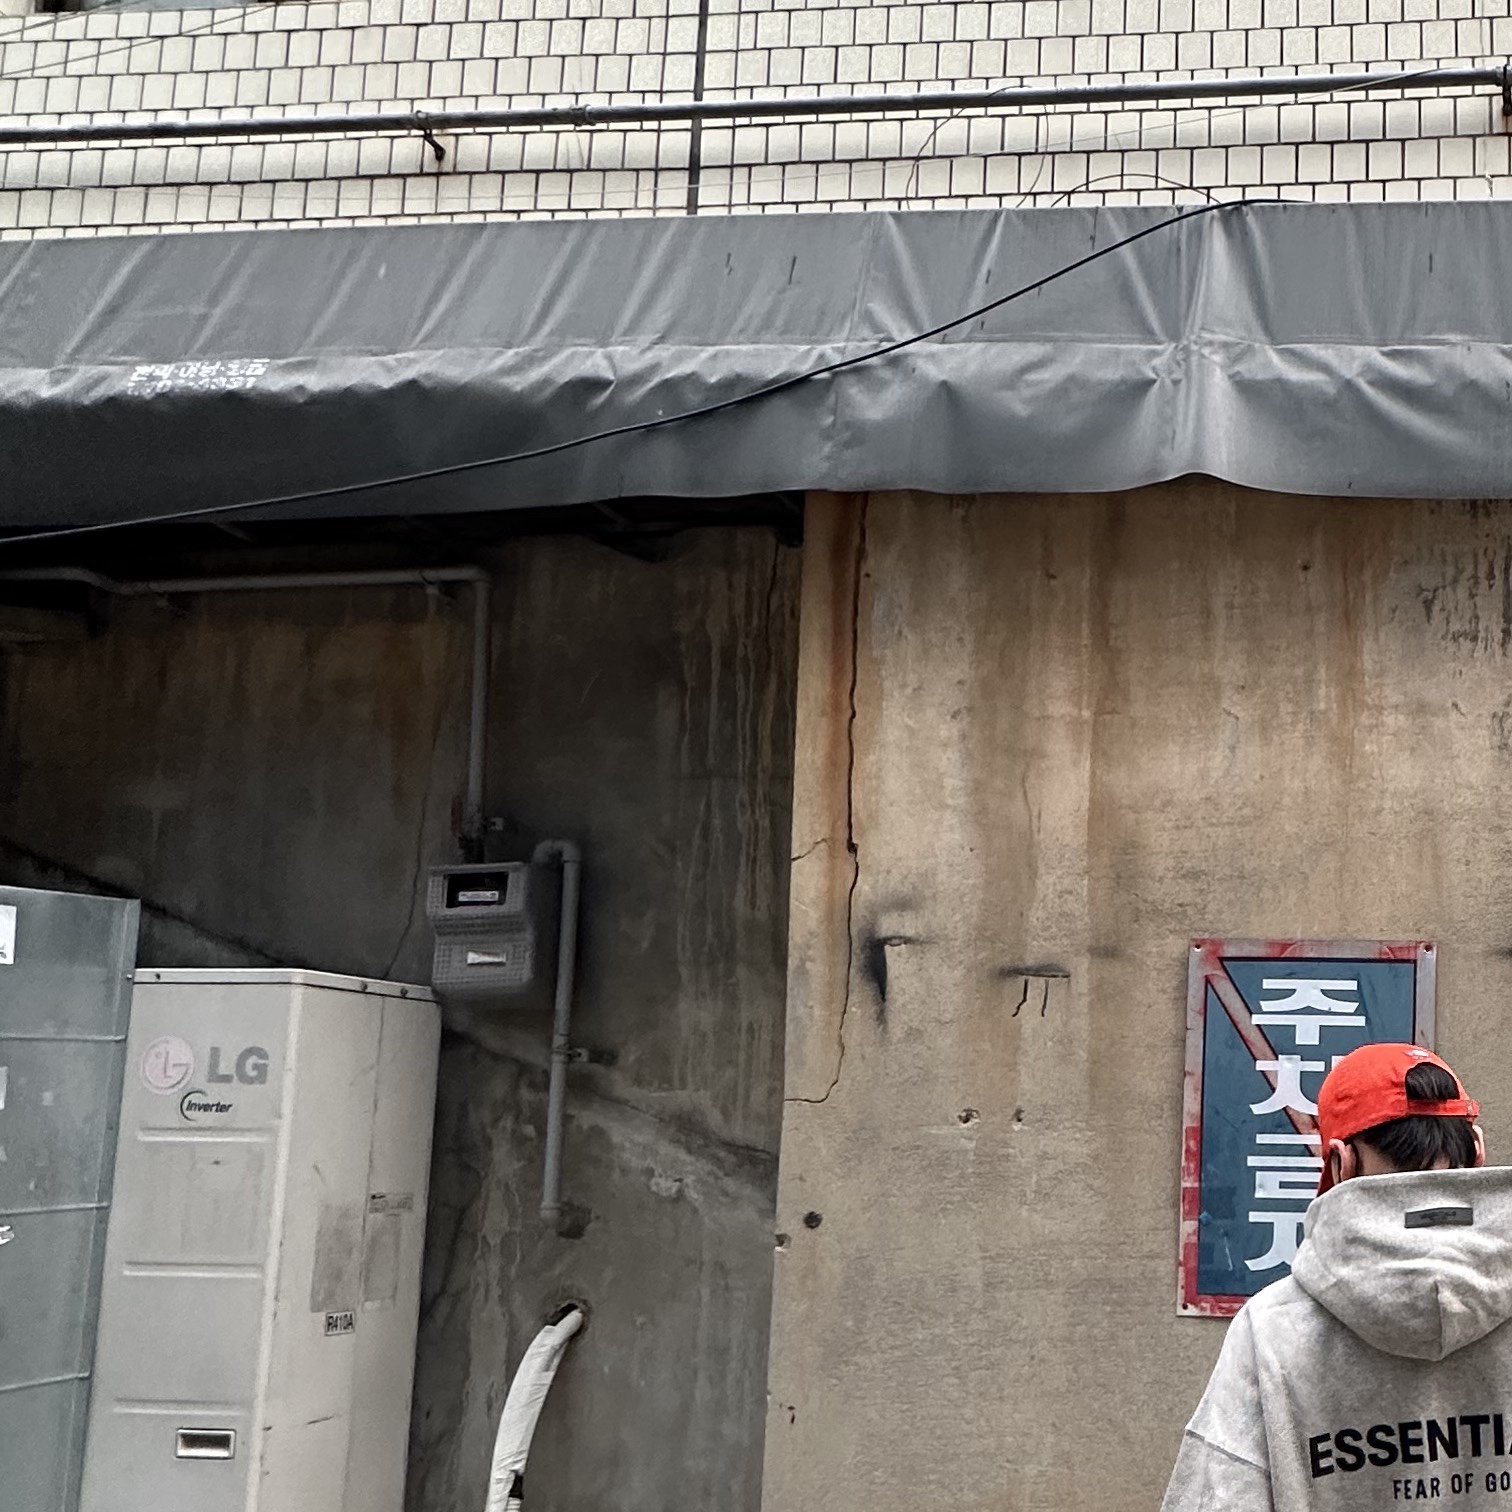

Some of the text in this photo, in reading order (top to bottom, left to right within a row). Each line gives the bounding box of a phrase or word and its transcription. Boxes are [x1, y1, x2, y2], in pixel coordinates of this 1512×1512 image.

[206, 1046, 270, 1085] LG
[185, 1099, 234, 1114] Inverter
[1392, 1477, 1441, 1500] FEAR
[1451, 1472, 1474, 1495] OF
